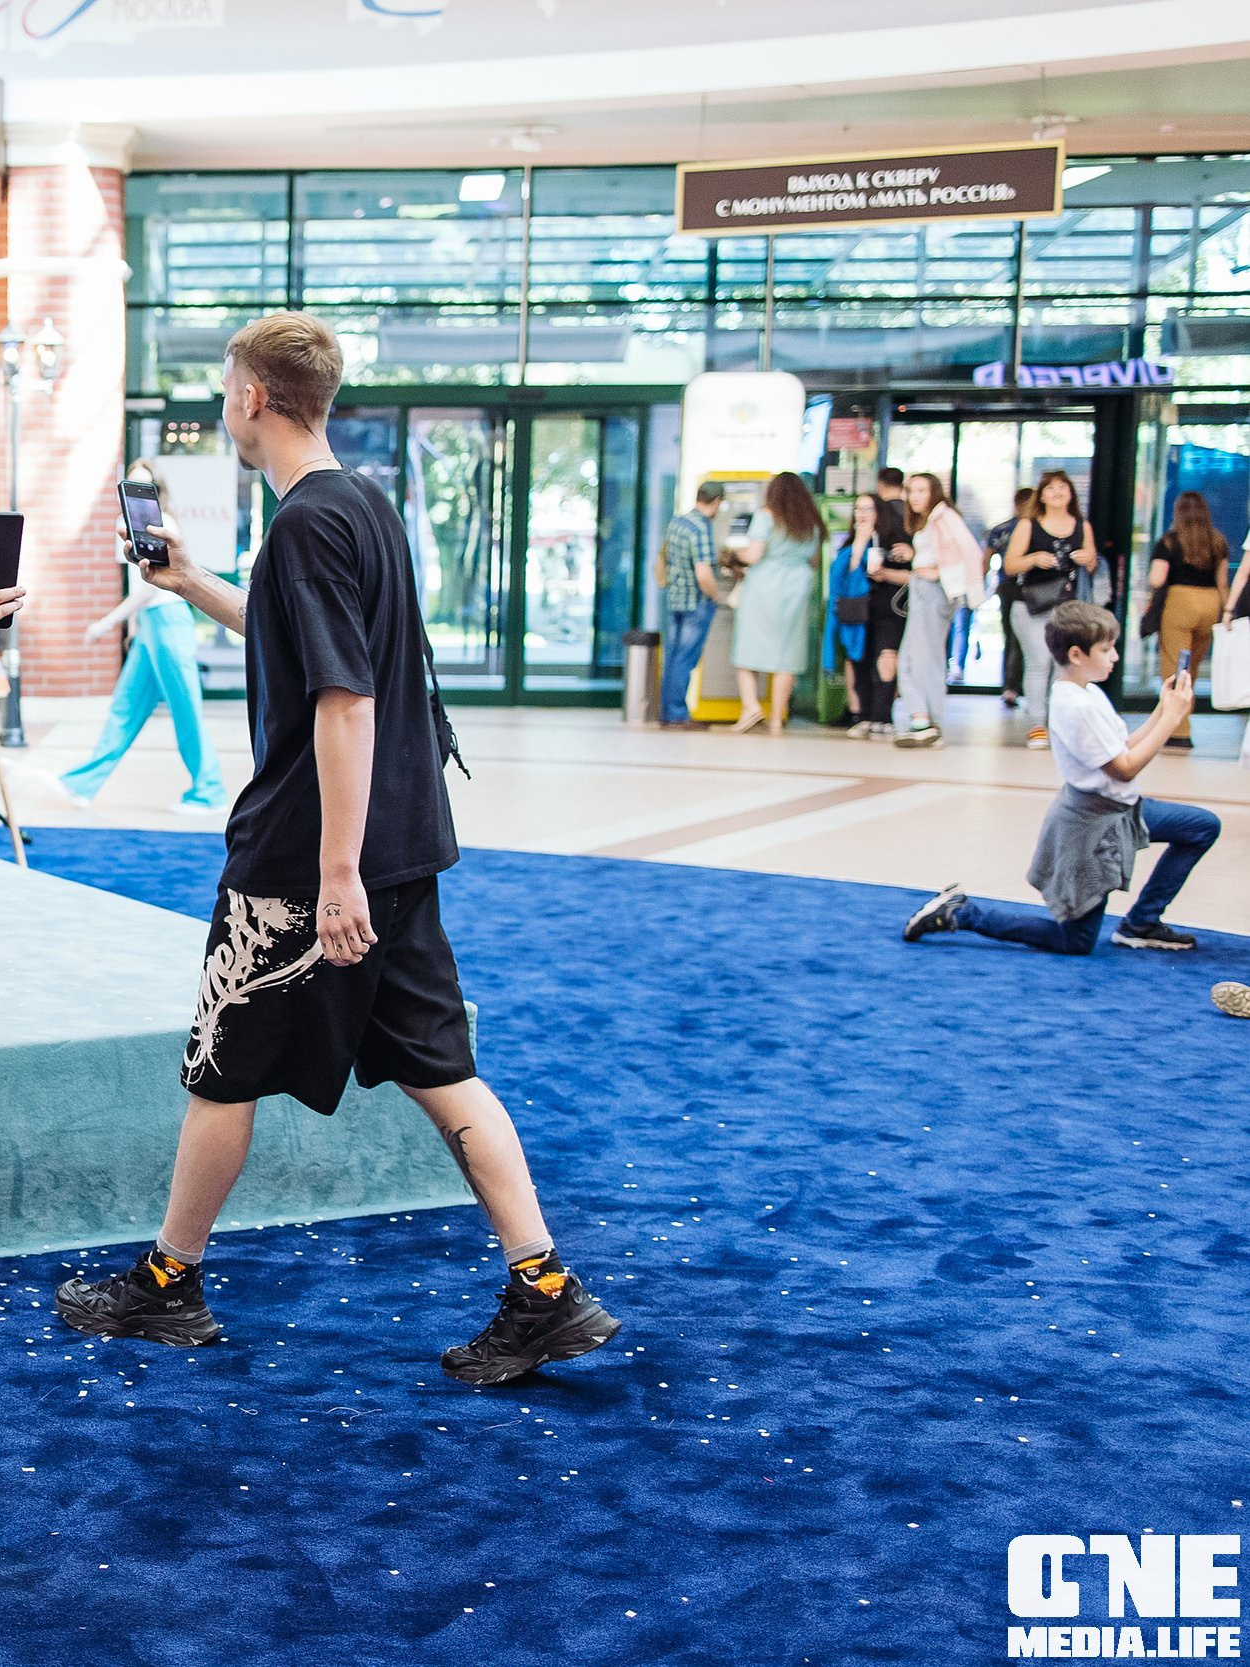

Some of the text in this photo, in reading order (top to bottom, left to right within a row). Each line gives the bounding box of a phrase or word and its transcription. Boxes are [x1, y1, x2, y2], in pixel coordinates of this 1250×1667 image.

[787, 167, 942, 194] ВЫХОД К СКВЕРУ
[732, 192, 867, 216] МОНУМЕНТОМ
[165, 1299, 184, 1309] FILA
